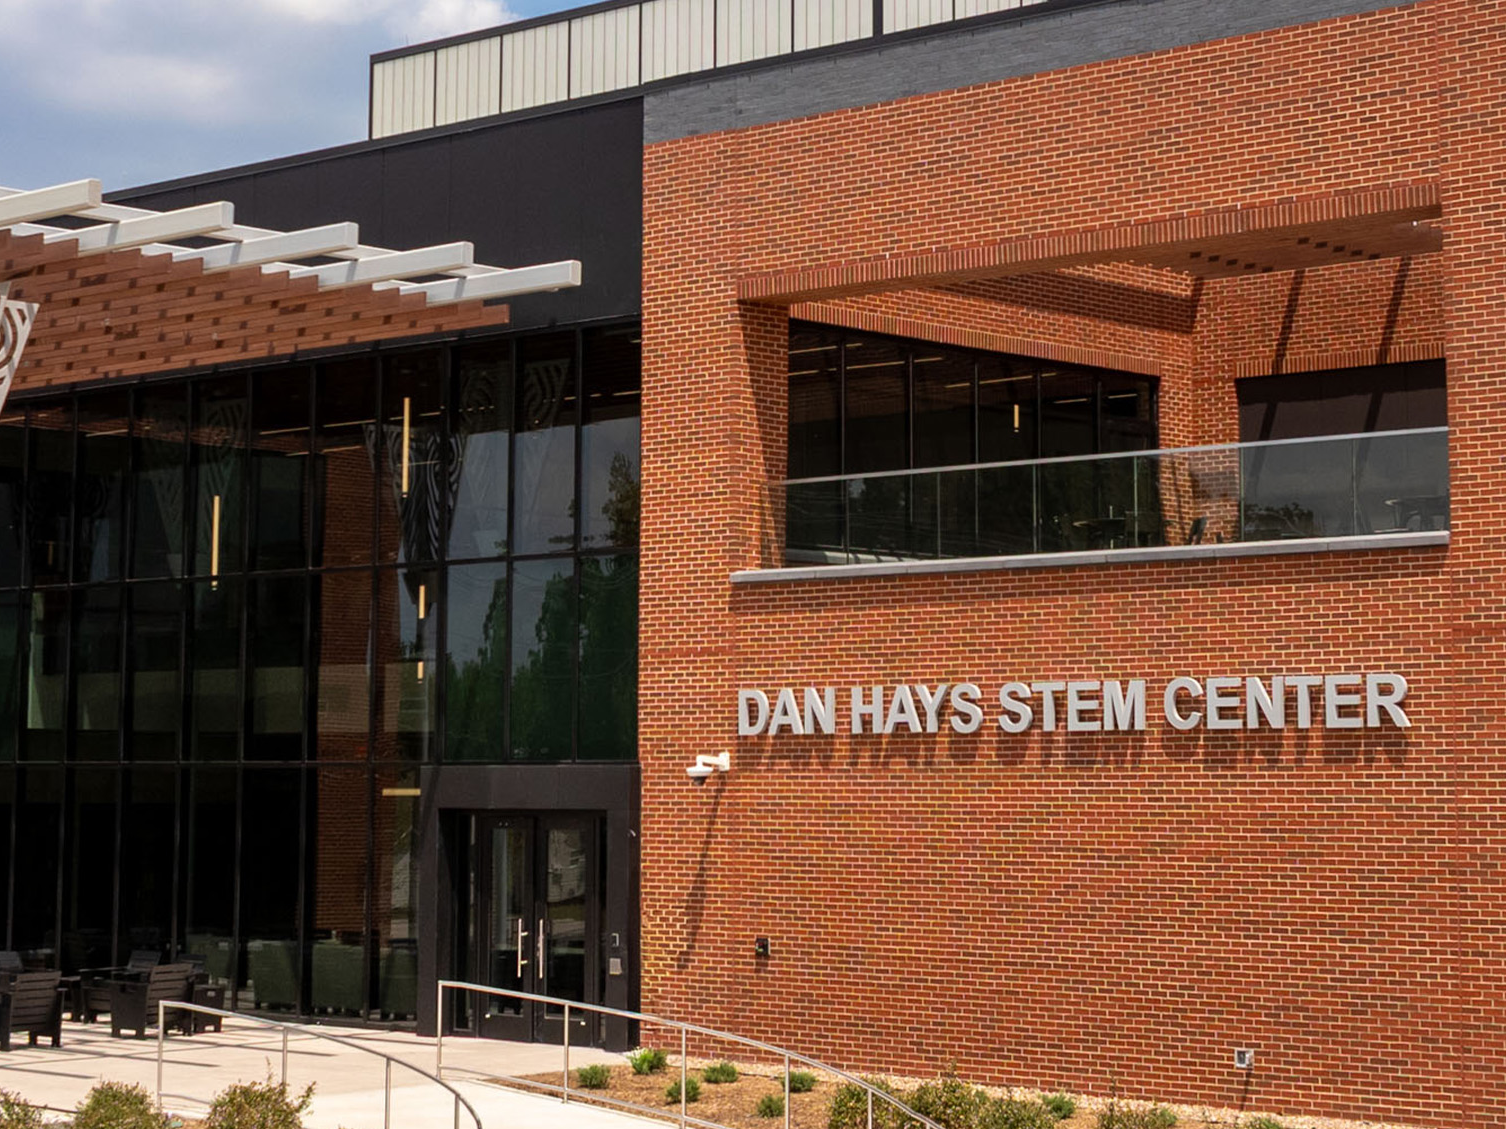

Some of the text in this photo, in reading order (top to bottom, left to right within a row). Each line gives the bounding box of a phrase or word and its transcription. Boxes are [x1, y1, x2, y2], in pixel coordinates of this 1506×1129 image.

[738, 674, 1412, 735] DAN HAYS STEM CENTER
